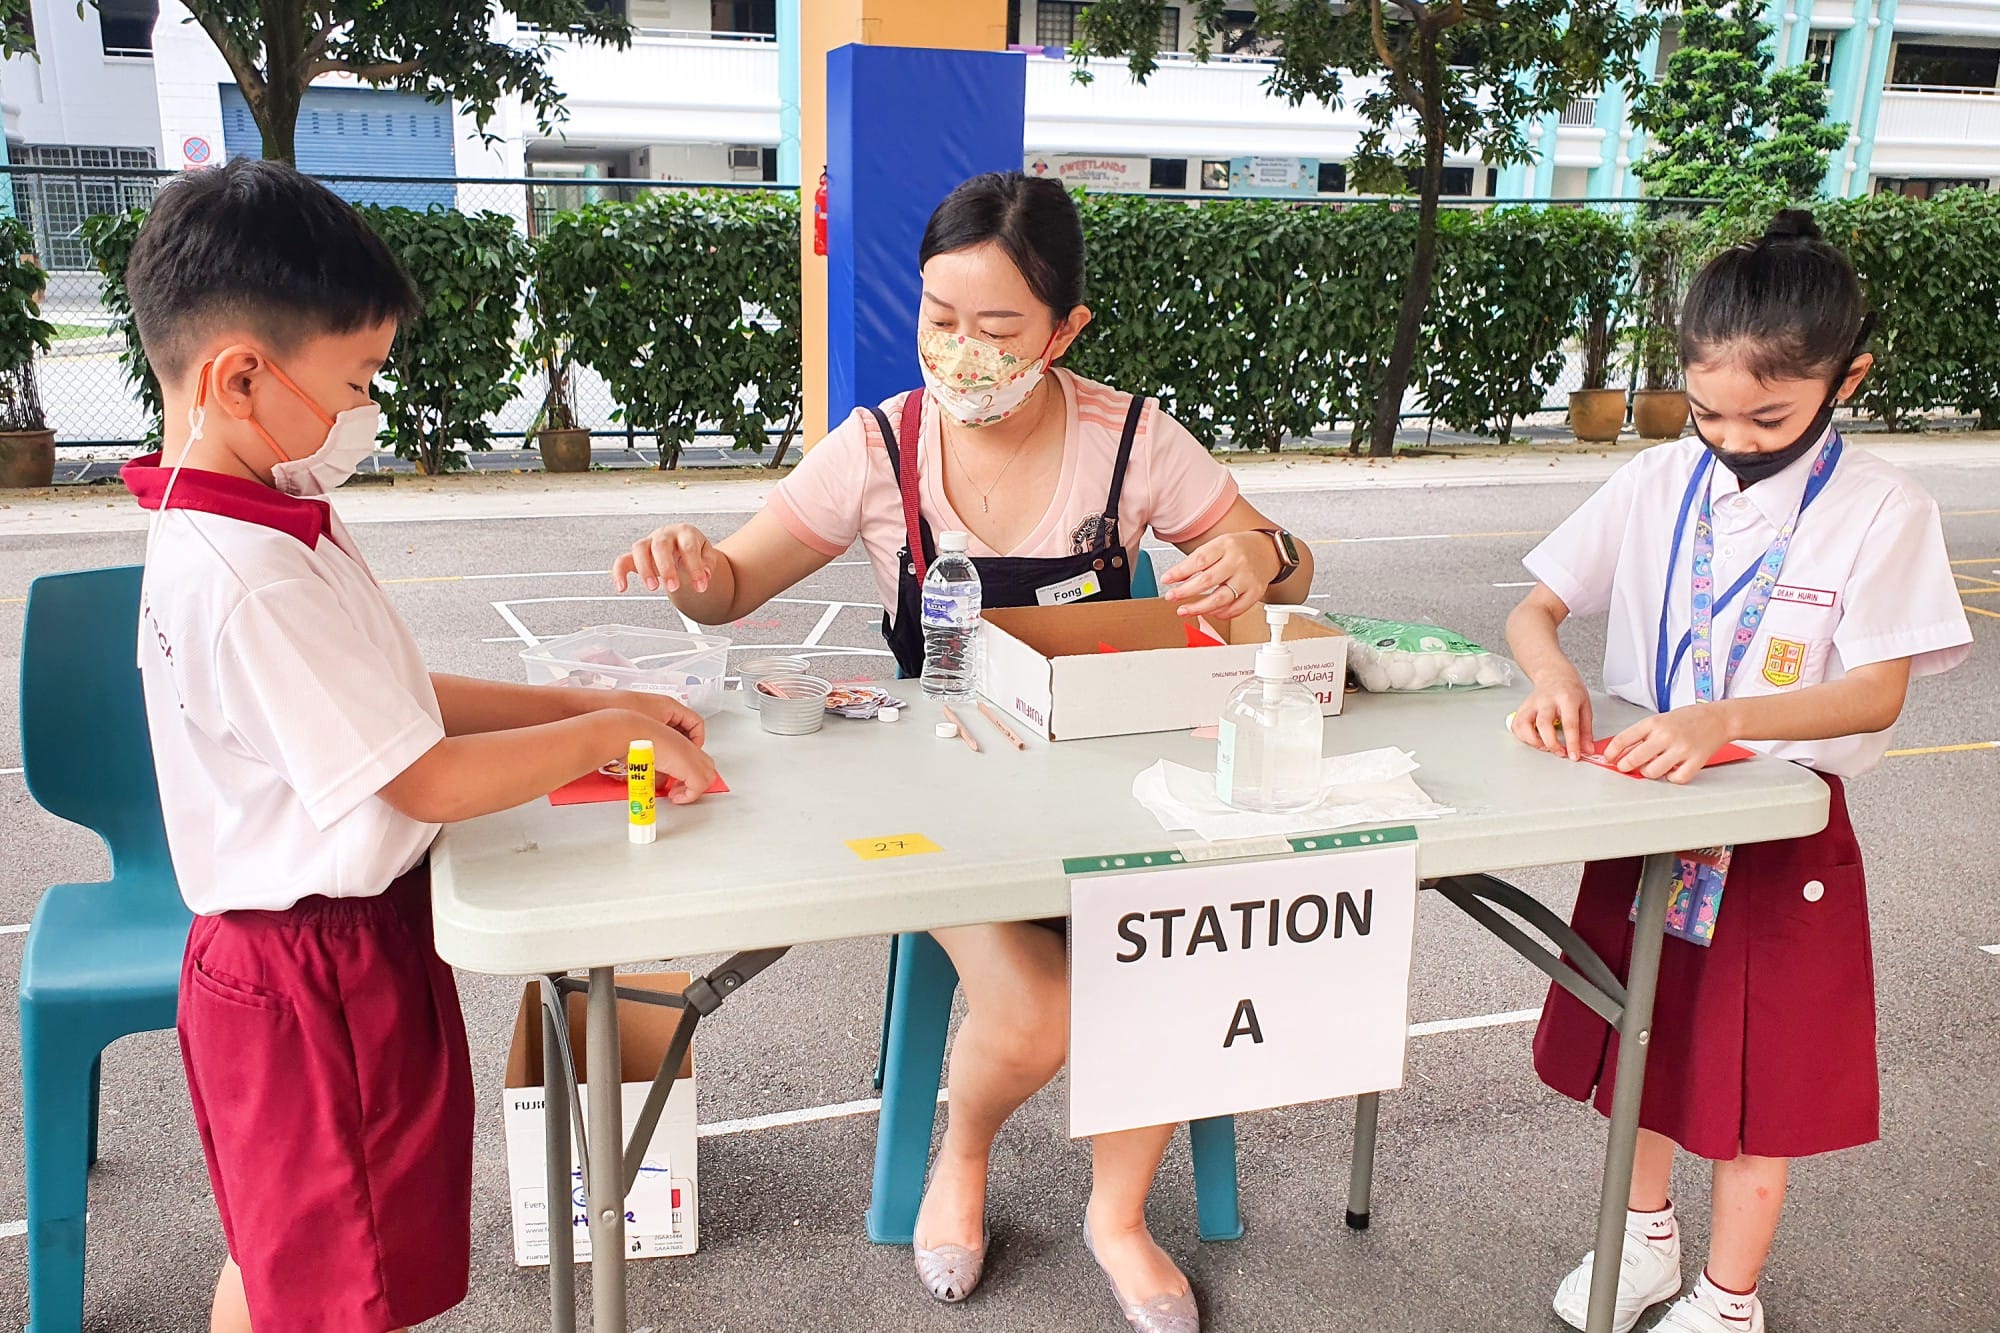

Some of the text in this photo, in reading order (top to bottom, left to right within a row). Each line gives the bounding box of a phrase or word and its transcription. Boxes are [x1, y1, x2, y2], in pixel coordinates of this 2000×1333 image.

[1059, 160, 1127, 175] SWEETLANDS
[1054, 587, 1082, 601] Fong
[1016, 696, 1043, 727] FUJIFILM
[629, 763, 648, 772] UHU
[874, 840, 908, 852] 27
[1116, 889, 1373, 963] STATION
[1223, 998, 1264, 1048] A
